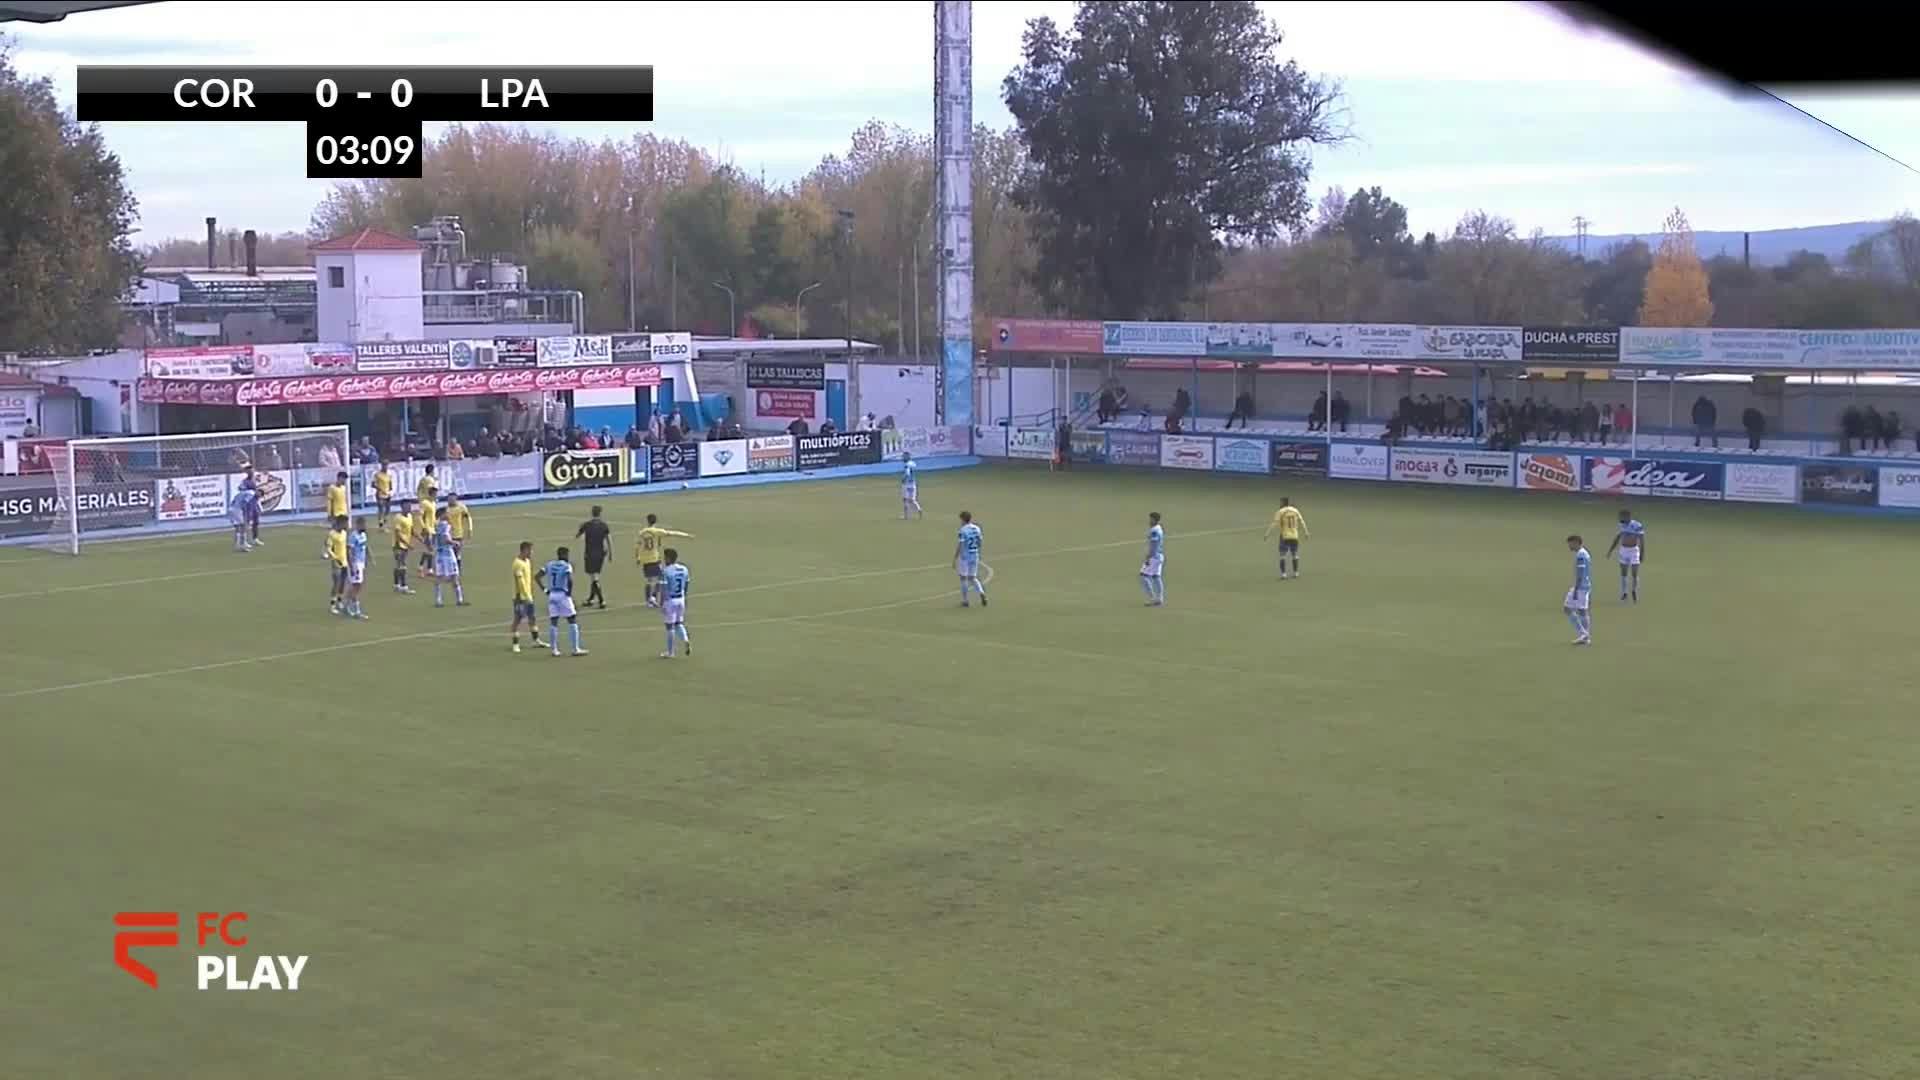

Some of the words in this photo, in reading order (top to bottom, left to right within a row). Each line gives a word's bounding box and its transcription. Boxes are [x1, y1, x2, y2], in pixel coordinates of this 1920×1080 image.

[1524, 331, 1568, 345] DUCHA
[1576, 331, 1618, 345] PREST
[356, 344, 403, 356] TALLERES
[653, 344, 688, 355] FEBEJO
[544, 452, 613, 487] Corón
